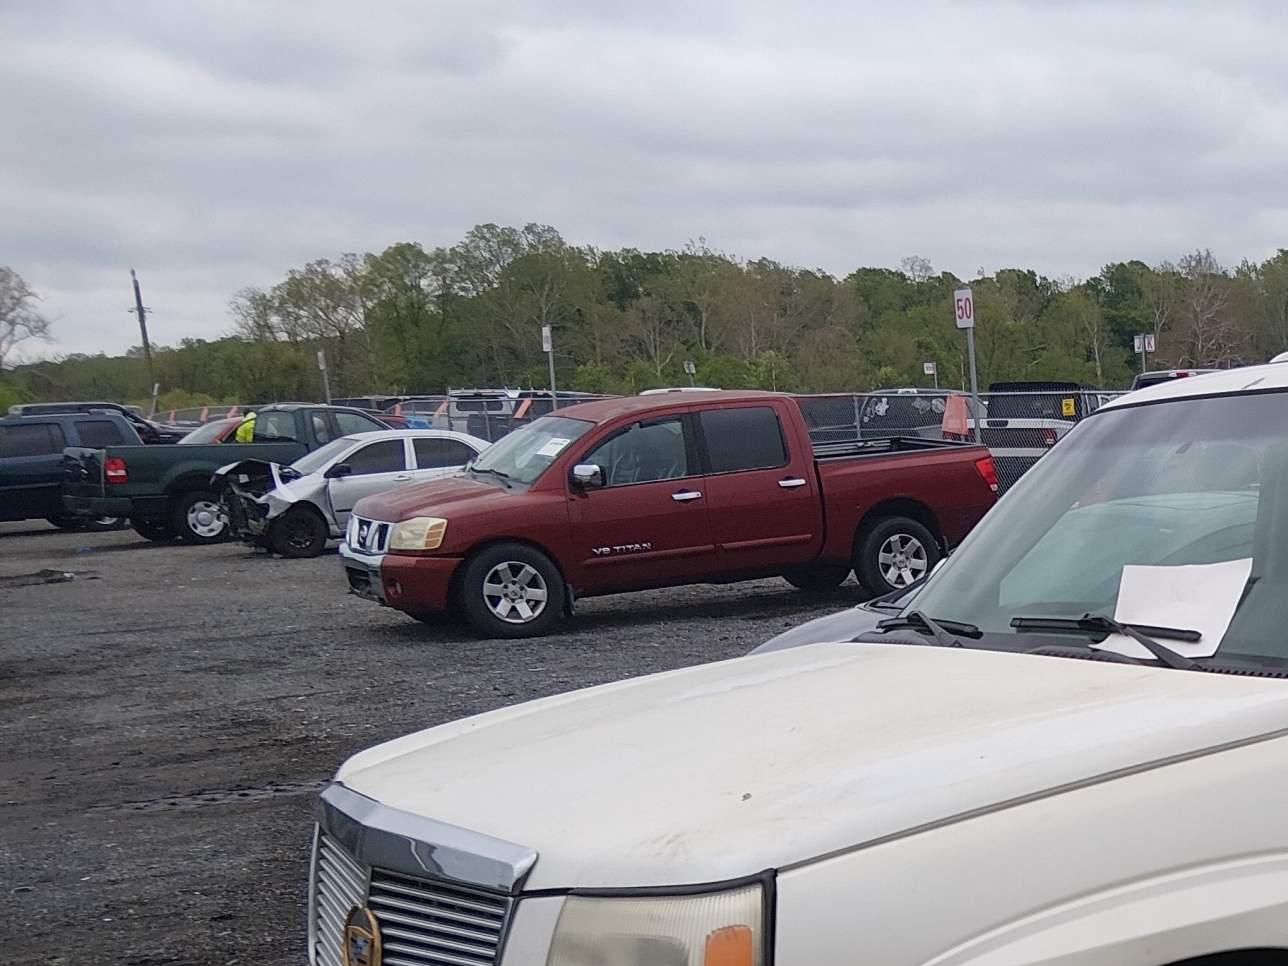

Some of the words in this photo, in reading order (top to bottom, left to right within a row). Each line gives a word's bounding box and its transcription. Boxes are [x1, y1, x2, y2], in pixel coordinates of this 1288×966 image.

[956, 297, 972, 320] 50
[1136, 337, 1142, 350] J
[1147, 336, 1153, 349] K
[592, 547, 611, 555] V8
[613, 542, 652, 553] TITAN
